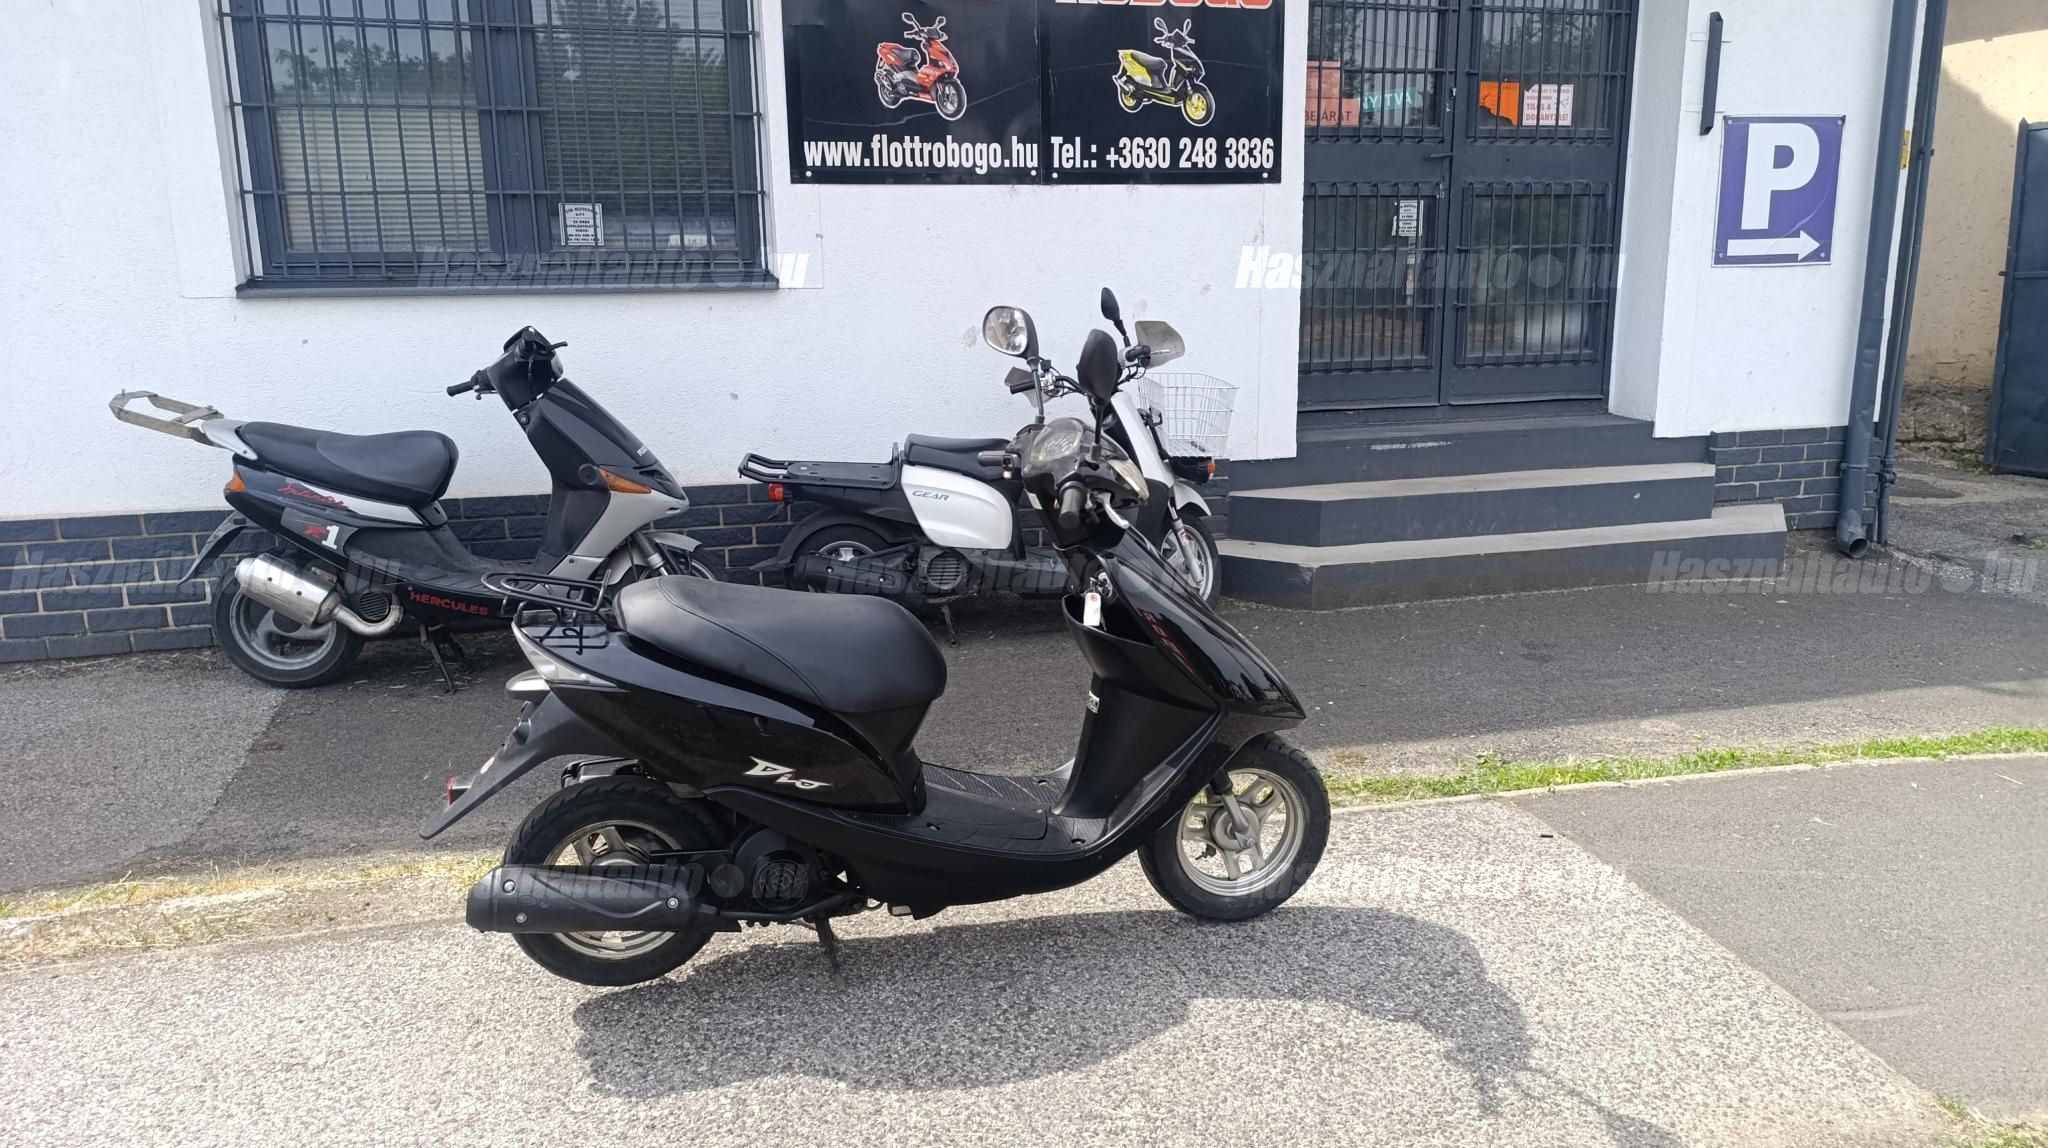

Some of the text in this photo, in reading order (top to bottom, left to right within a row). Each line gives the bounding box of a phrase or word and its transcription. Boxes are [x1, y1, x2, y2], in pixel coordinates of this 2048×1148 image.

[1362, 91, 1413, 109] NYTVA
[803, 134, 1039, 174] www.flottrobogo.hu
[1051, 136, 1274, 169] Tel.: +3630 248 3836
[1741, 123, 1820, 230] P
[912, 490, 949, 501] GEAR
[410, 591, 489, 615] HERCULES
